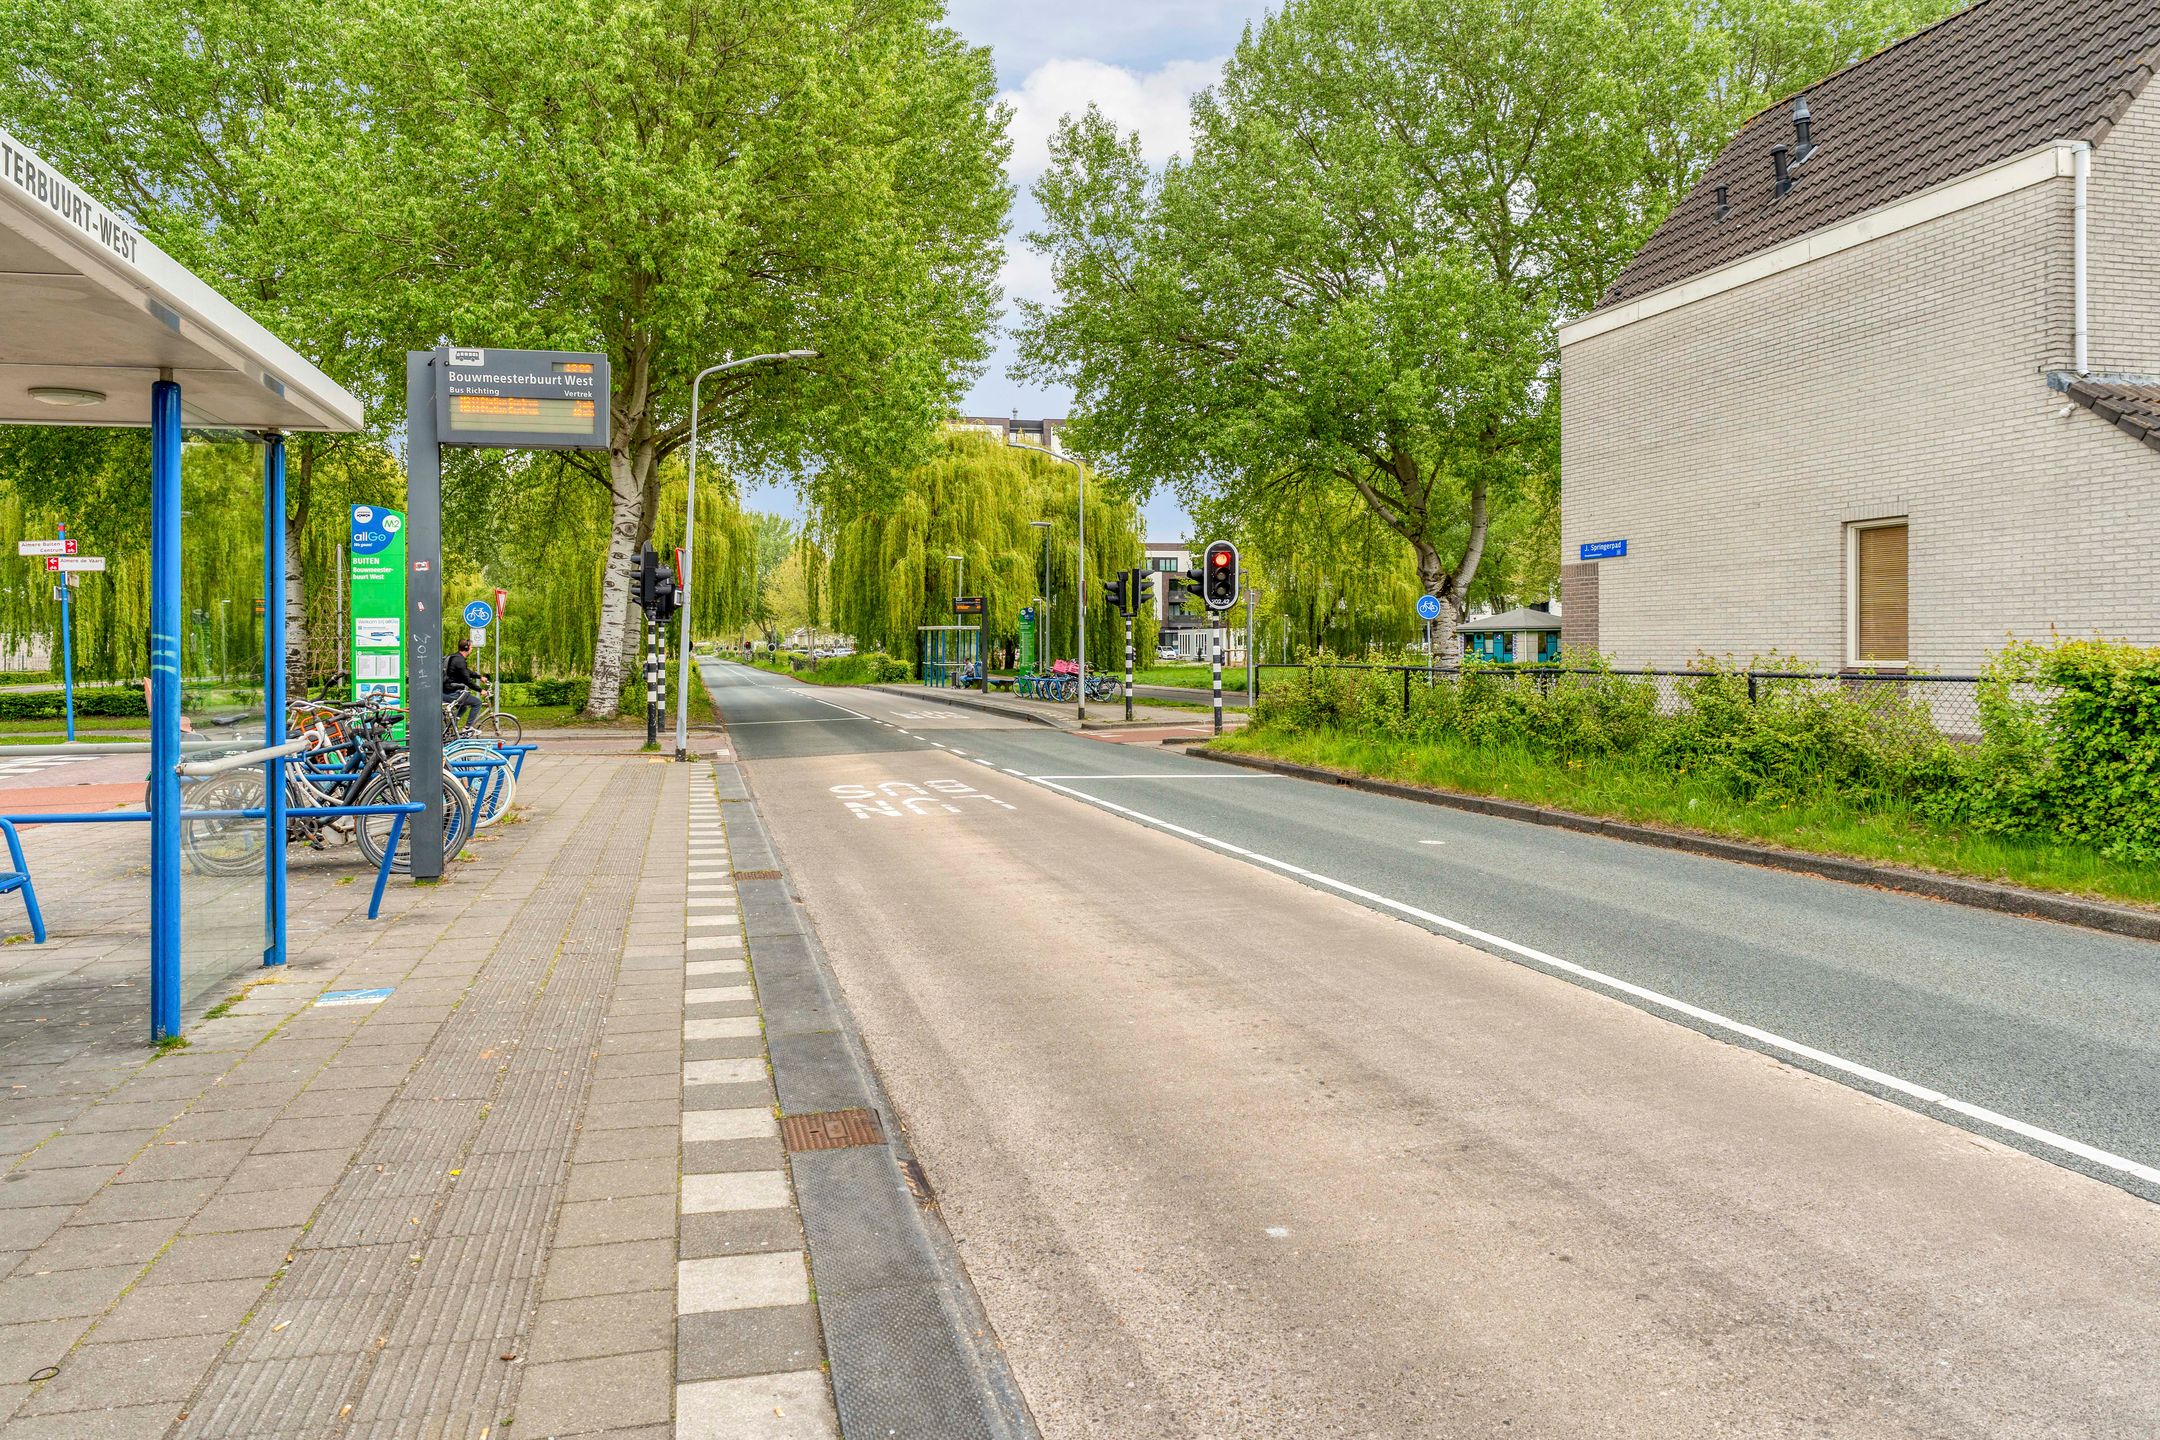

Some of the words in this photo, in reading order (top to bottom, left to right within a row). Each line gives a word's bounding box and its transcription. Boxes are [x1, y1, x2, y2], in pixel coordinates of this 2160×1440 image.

[1, 141, 138, 264] TERBUURT-WEST
[448, 371, 562, 386] Bouwmeesterbuurt
[564, 375, 594, 387] West
[449, 386, 464, 394] Bus
[466, 387, 500, 396] Richting
[564, 390, 593, 398] Vertrek
[353, 531, 387, 542] allGo
[1590, 541, 1621, 551] Springerpad
[352, 557, 380, 565] BUITEN
